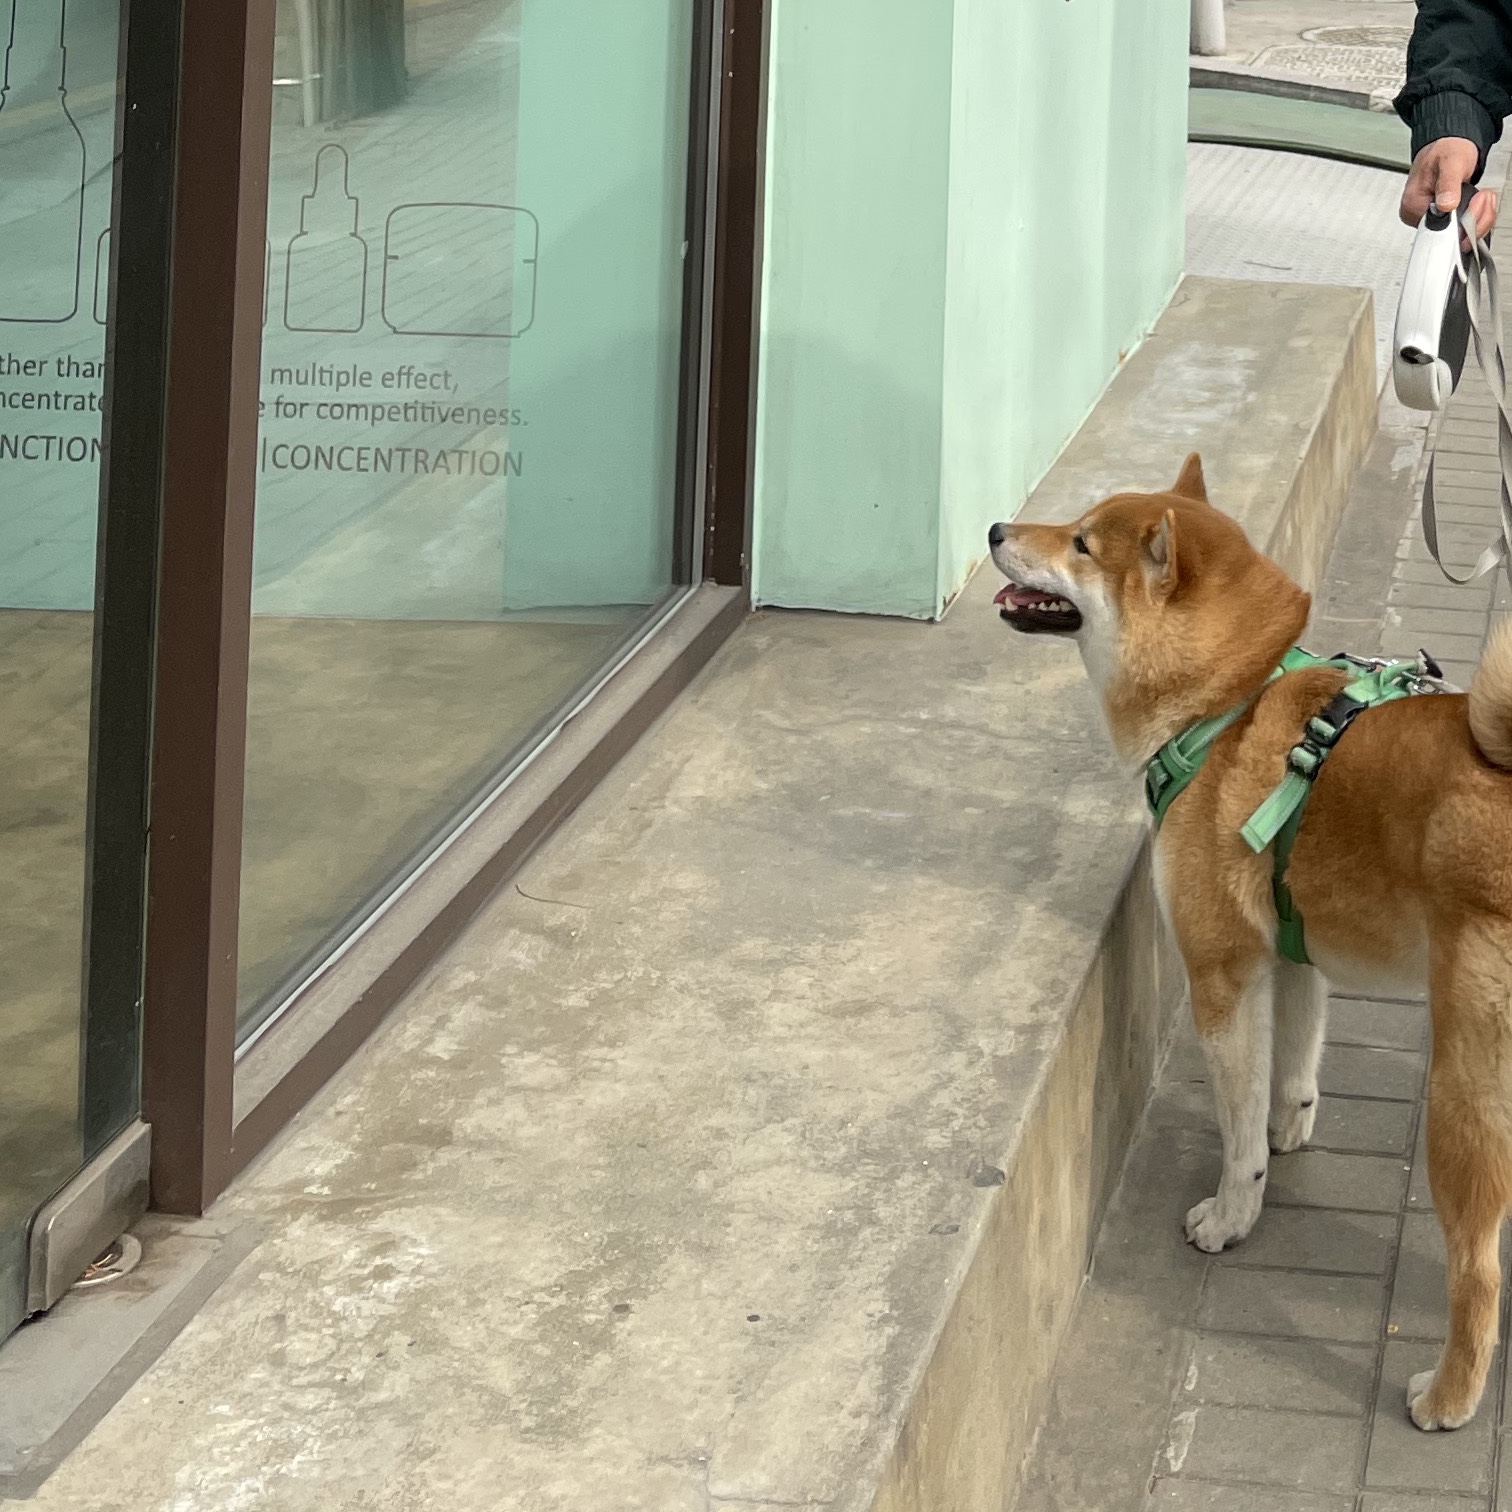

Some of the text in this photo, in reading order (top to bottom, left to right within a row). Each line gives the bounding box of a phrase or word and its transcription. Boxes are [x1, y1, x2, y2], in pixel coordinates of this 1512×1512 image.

[270, 363, 373, 393] multiple
[380, 365, 460, 395] effect,
[275, 395, 310, 419] for
[315, 401, 529, 427] competitiveness.
